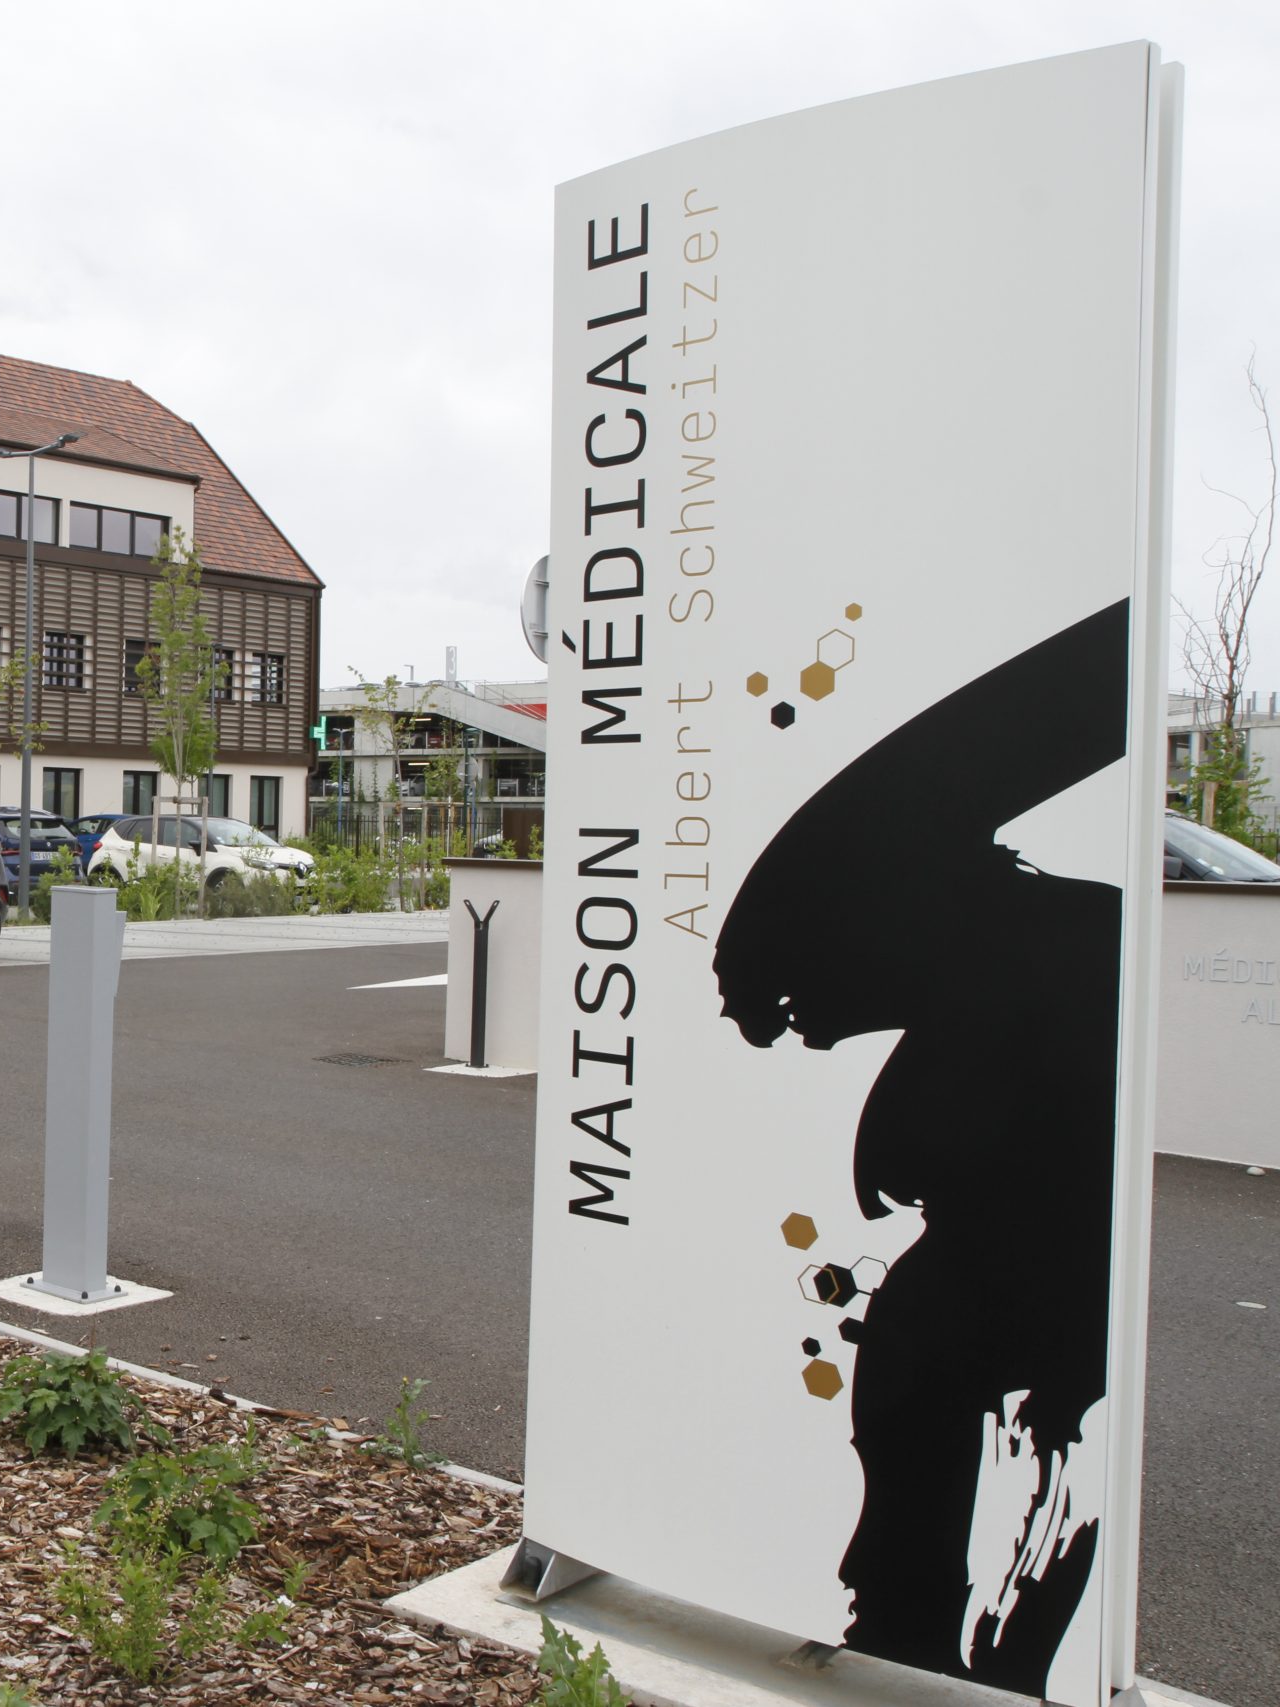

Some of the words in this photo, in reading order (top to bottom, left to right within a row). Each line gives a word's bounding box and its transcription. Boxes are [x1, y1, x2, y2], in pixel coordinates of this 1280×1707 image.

[562, 202, 649, 745] MÉDICALE
[668, 187, 719, 624] Schweitzer
[663, 679, 714, 940] Albert
[1182, 947, 1280, 986] MÉDI
[568, 827, 640, 1226] MAISON
